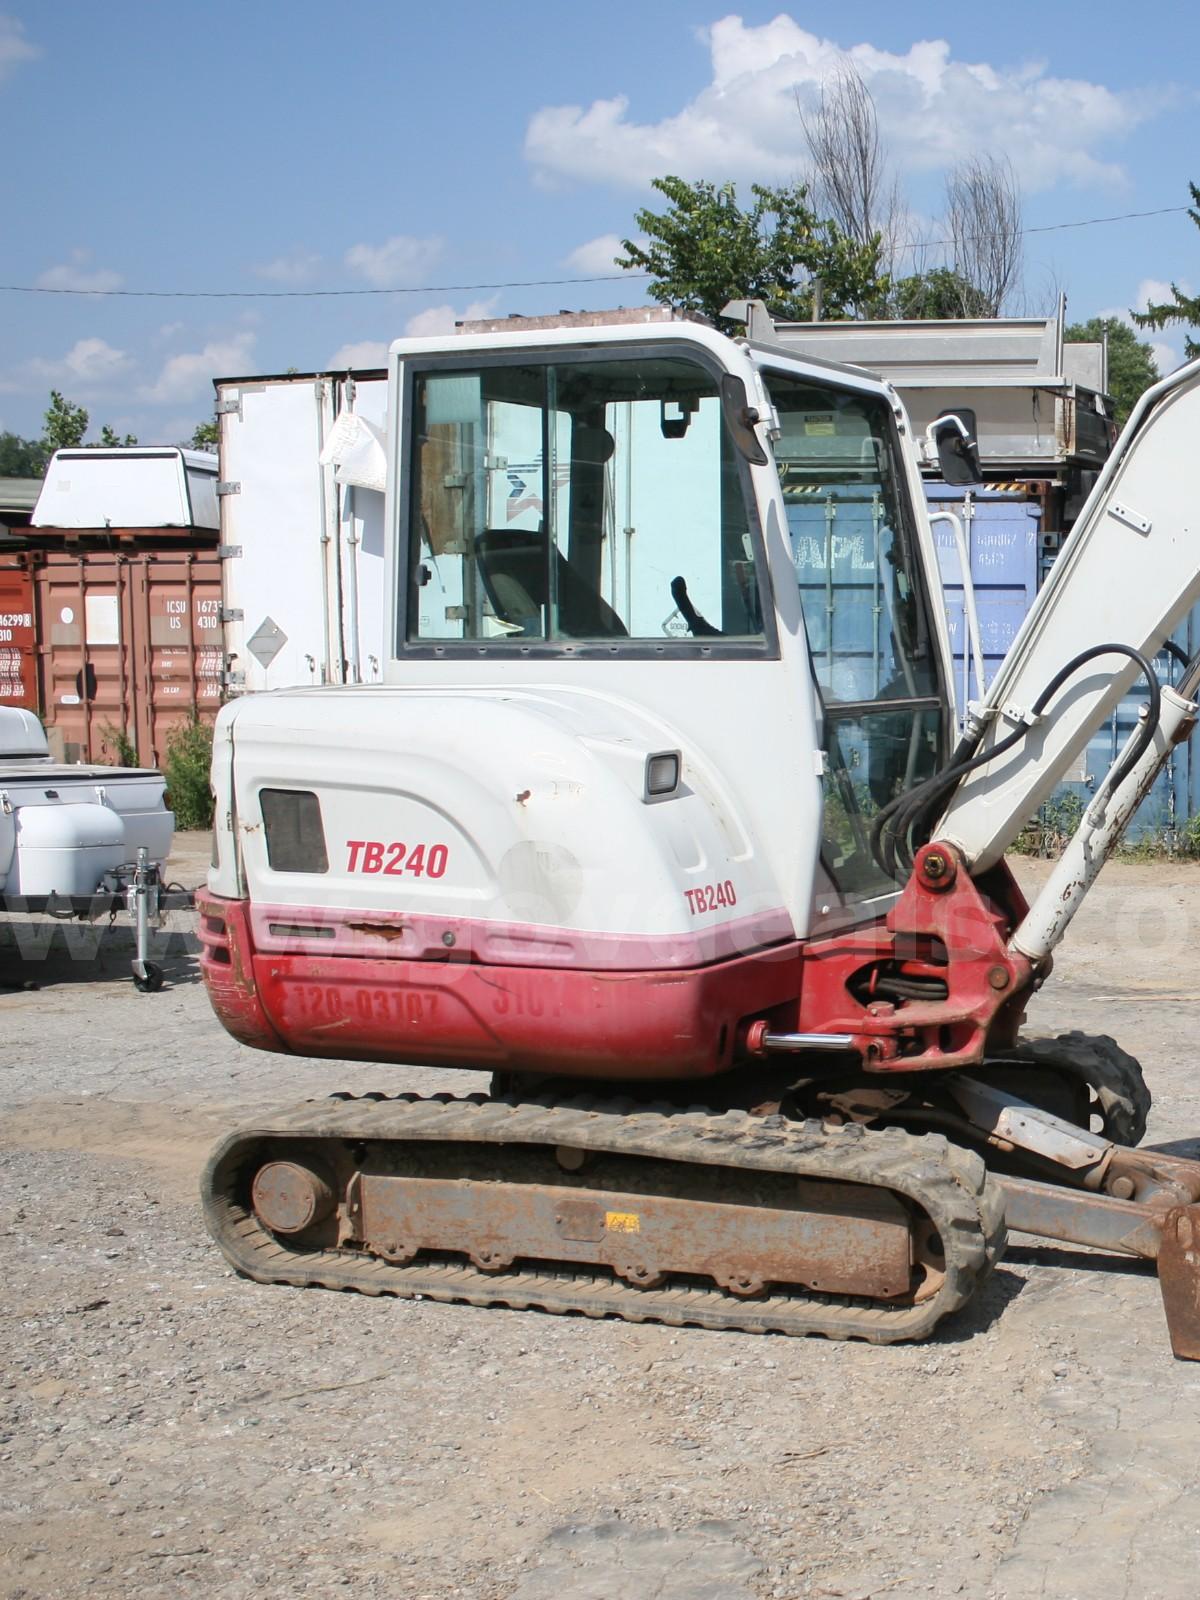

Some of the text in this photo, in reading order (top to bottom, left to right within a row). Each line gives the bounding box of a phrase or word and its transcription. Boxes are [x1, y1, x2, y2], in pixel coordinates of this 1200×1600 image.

[167, 600, 186, 614] ICSU
[170, 616, 217, 629] US 4310
[346, 840, 449, 879] TB240
[684, 879, 736, 915] TB240
